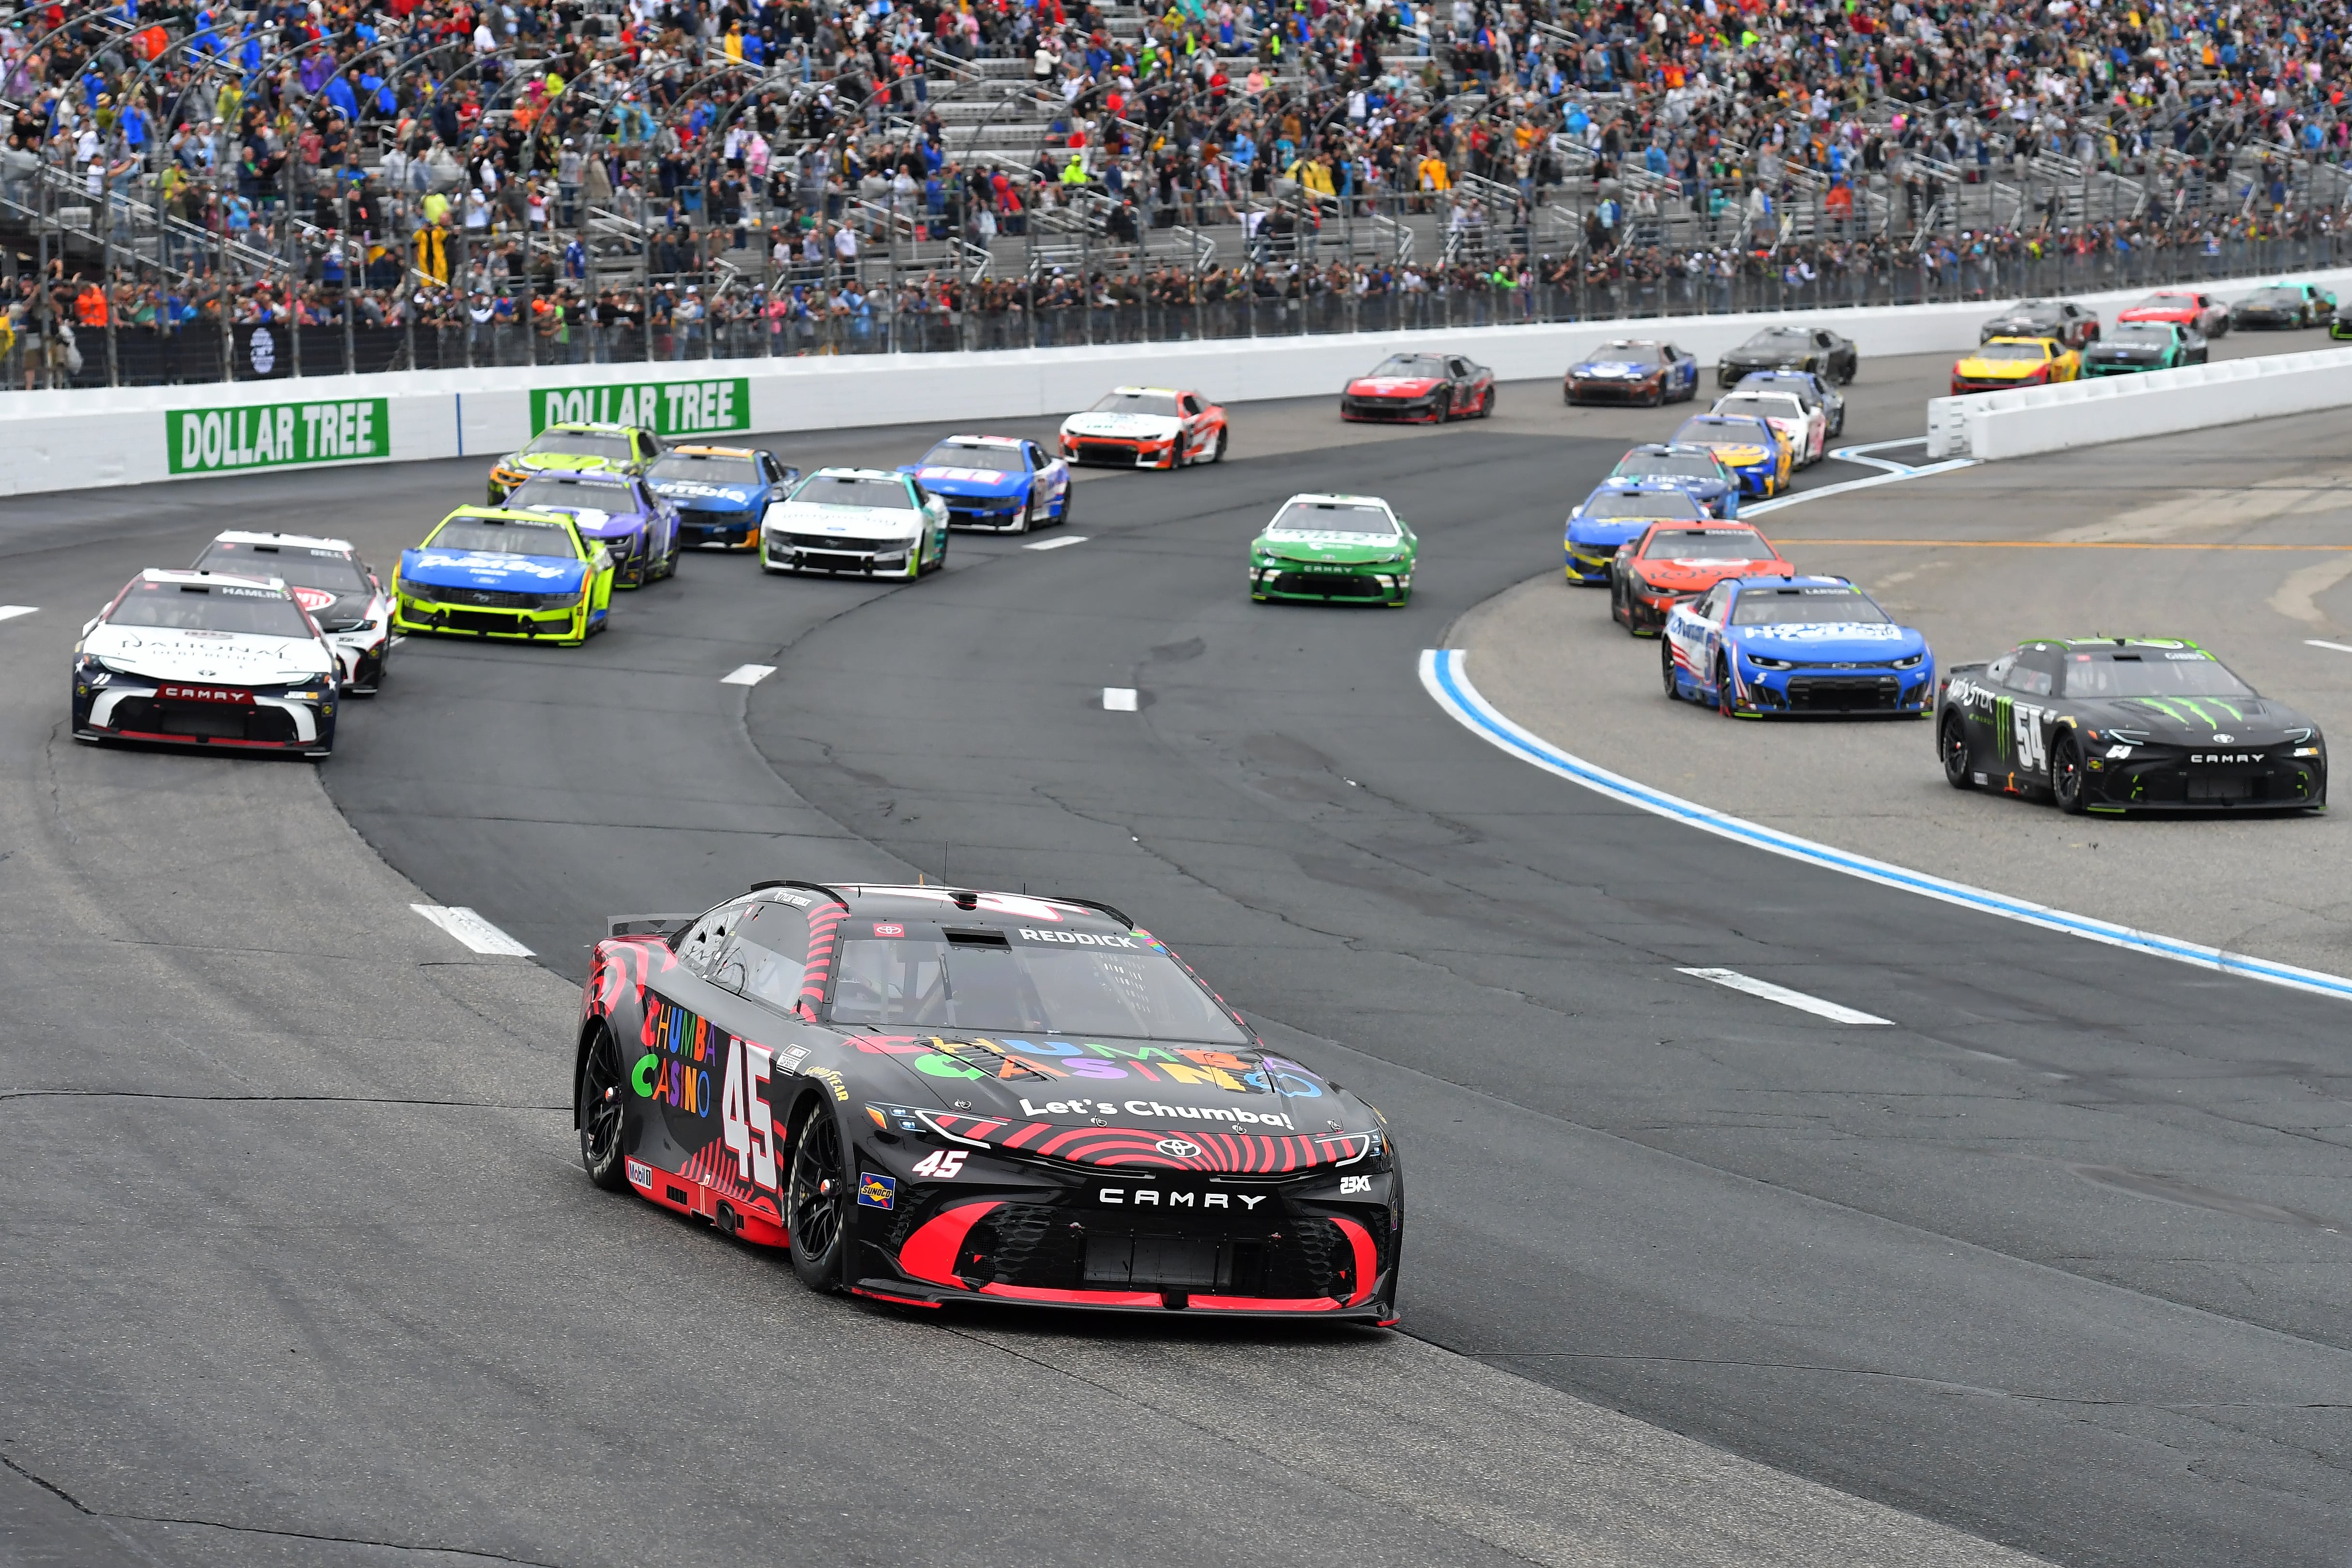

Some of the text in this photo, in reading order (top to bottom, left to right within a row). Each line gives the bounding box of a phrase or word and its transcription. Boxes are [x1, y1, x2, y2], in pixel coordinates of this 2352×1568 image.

[664, 381, 734, 431] TREE
[181, 403, 373, 469] DOLLAR TREE
[222, 587, 282, 599] HAMLIN
[166, 687, 245, 701] CAMRY
[2012, 701, 2049, 776] 54
[2106, 745, 2133, 759] 54
[2190, 753, 2265, 763] CAMRY
[1017, 928, 1140, 949] REDDICK
[640, 993, 717, 1067] CHUMBA
[839, 1034, 1323, 1081] CHUMBA
[631, 1053, 711, 1118] CASINO
[804, 1066, 850, 1102] GOODYEAR
[914, 1053, 1322, 1098] CASINO
[722, 1035, 777, 1190] 45
[1018, 1098, 1295, 1131] Let's Chumba!
[629, 1163, 645, 1184] Mobil
[911, 1149, 970, 1178] 45
[862, 1186, 892, 1198] SUNOCO
[1099, 1188, 1267, 1210] CAMRY
